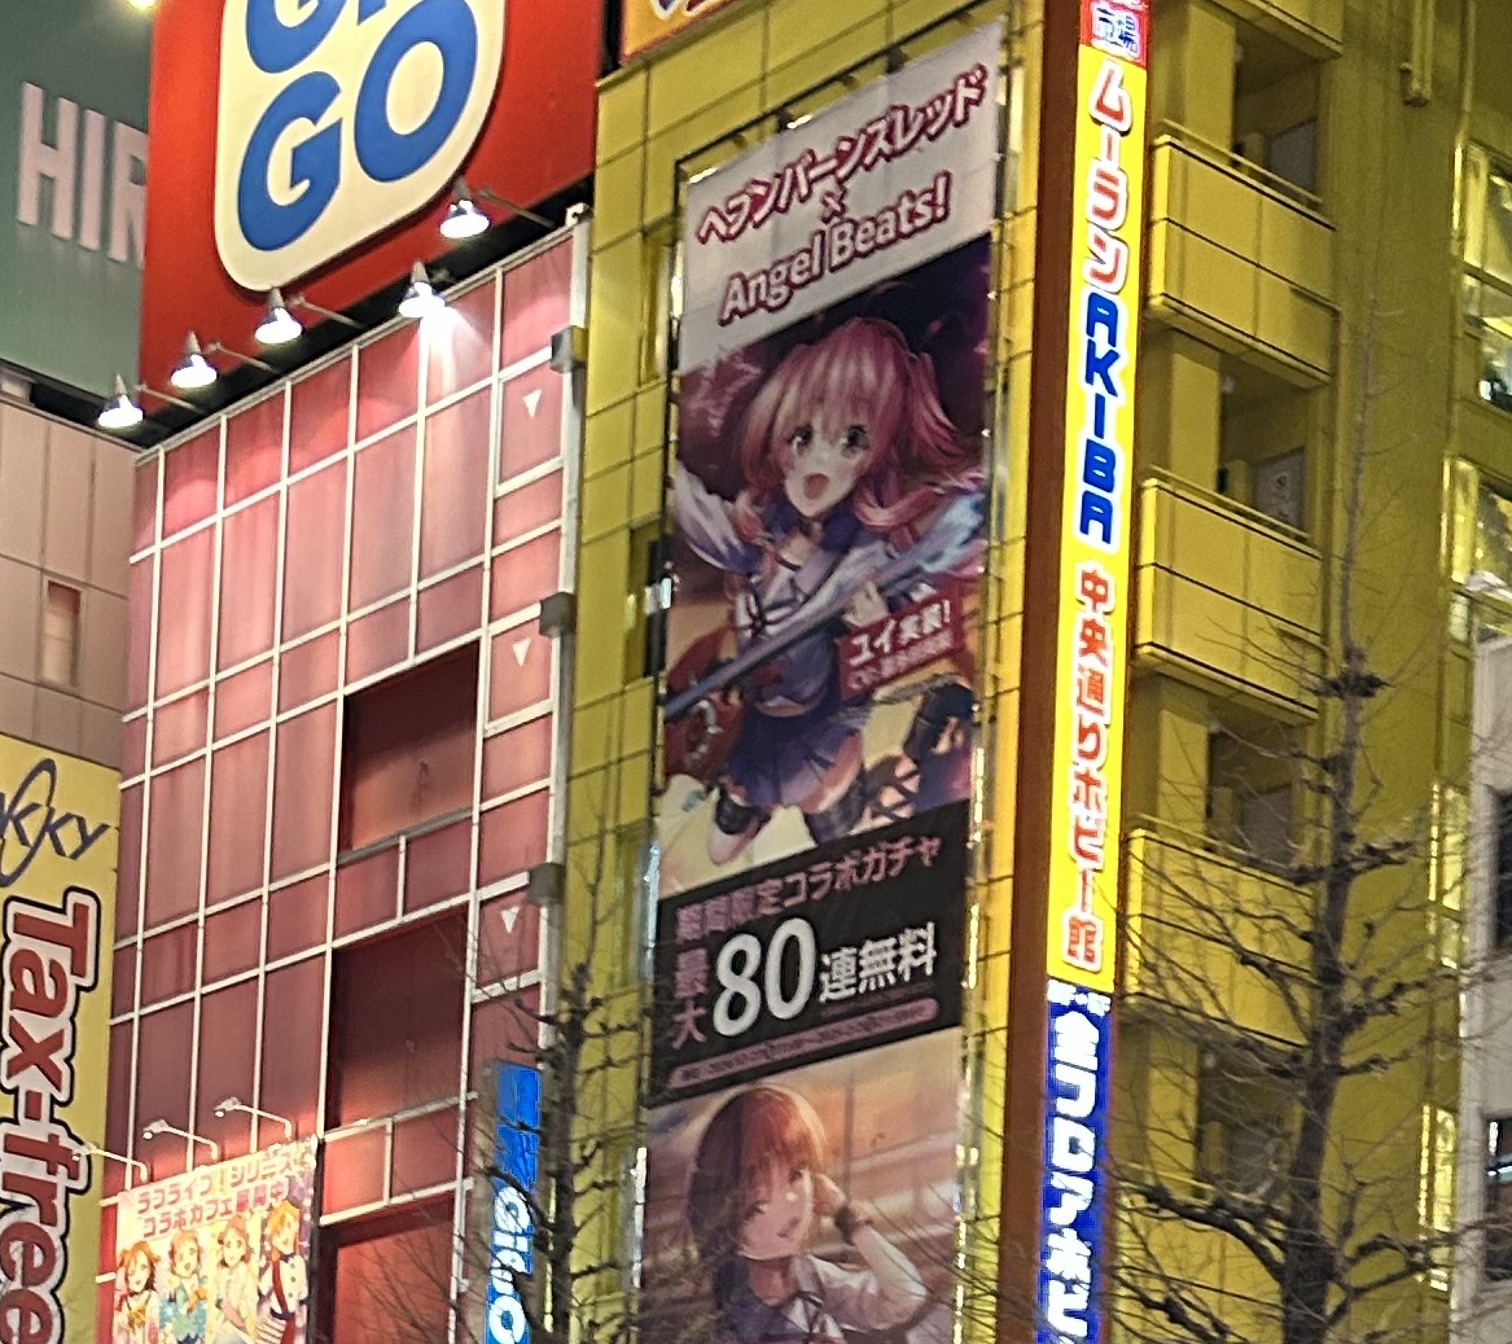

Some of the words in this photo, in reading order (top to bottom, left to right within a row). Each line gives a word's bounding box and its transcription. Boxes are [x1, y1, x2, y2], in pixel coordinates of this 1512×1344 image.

[237, 0, 479, 252] GO
[717, 225, 825, 328] Angel
[826, 169, 953, 276] Beats!
